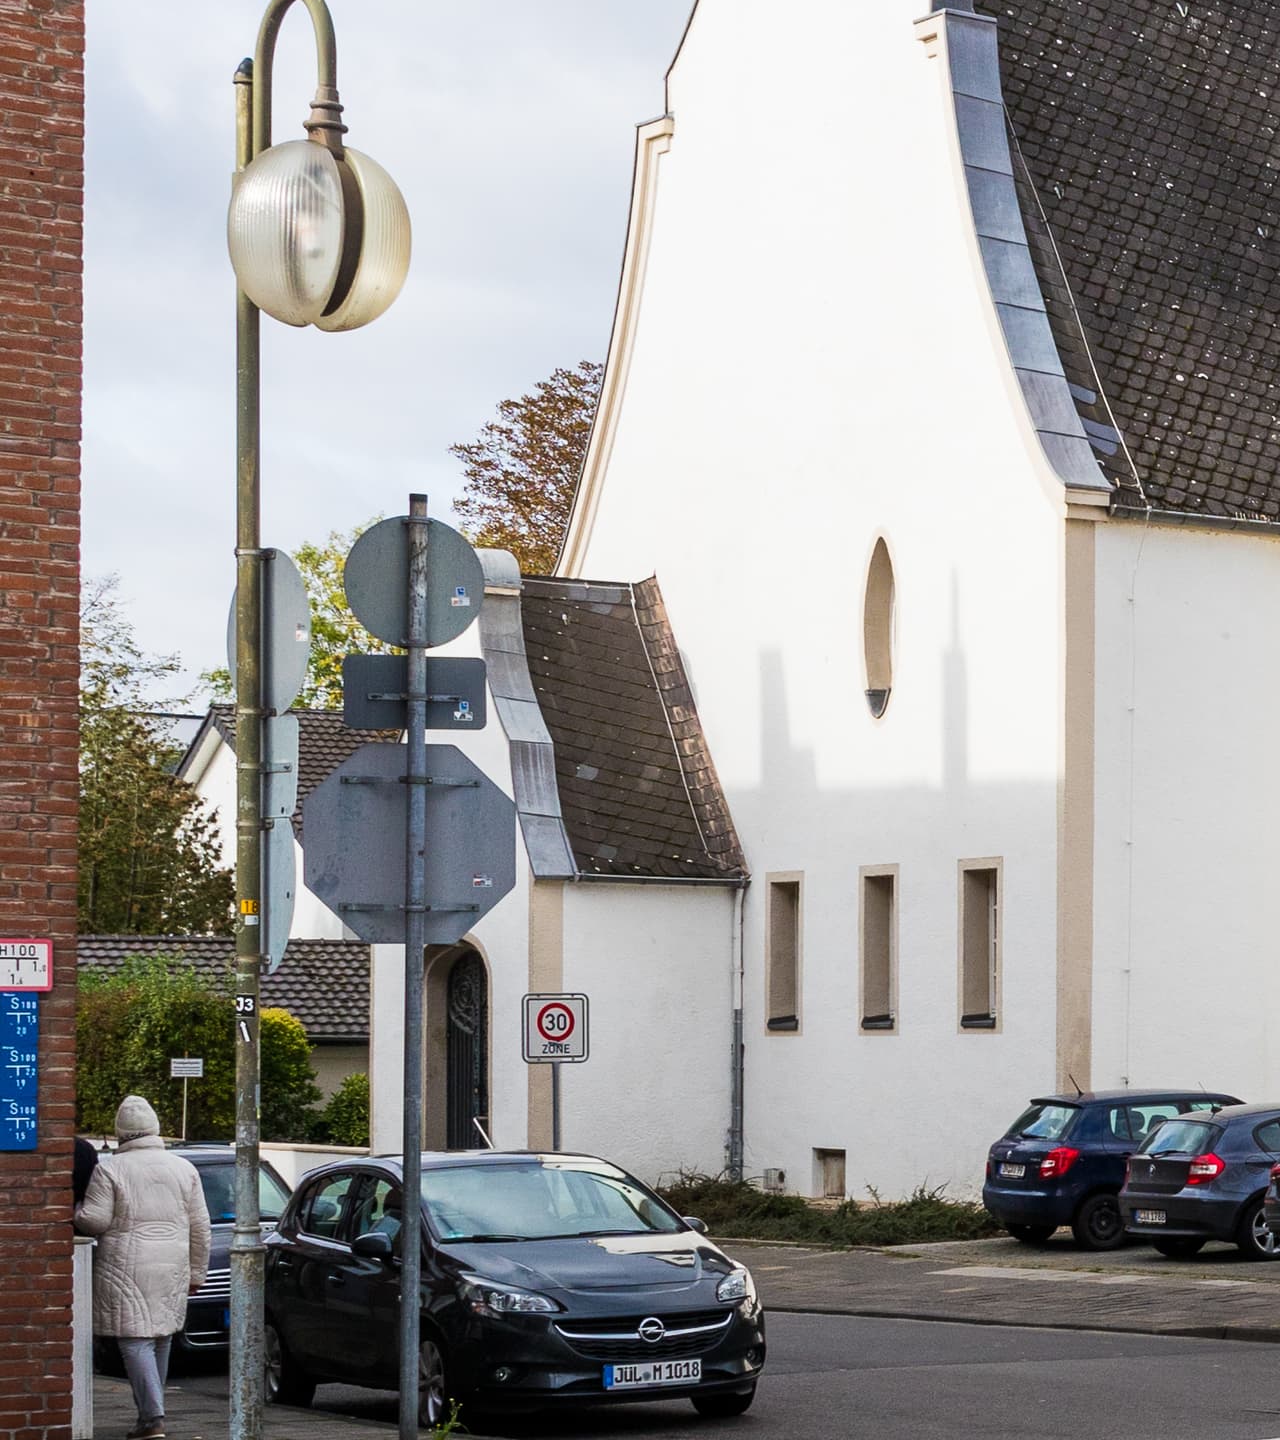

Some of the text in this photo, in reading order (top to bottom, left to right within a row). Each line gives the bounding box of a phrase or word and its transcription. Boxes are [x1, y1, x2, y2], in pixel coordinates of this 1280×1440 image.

[545, 1013, 567, 1031] 30
[541, 1043, 571, 1054] ZONE
[614, 1361, 700, 1383] JÜL M 1018
